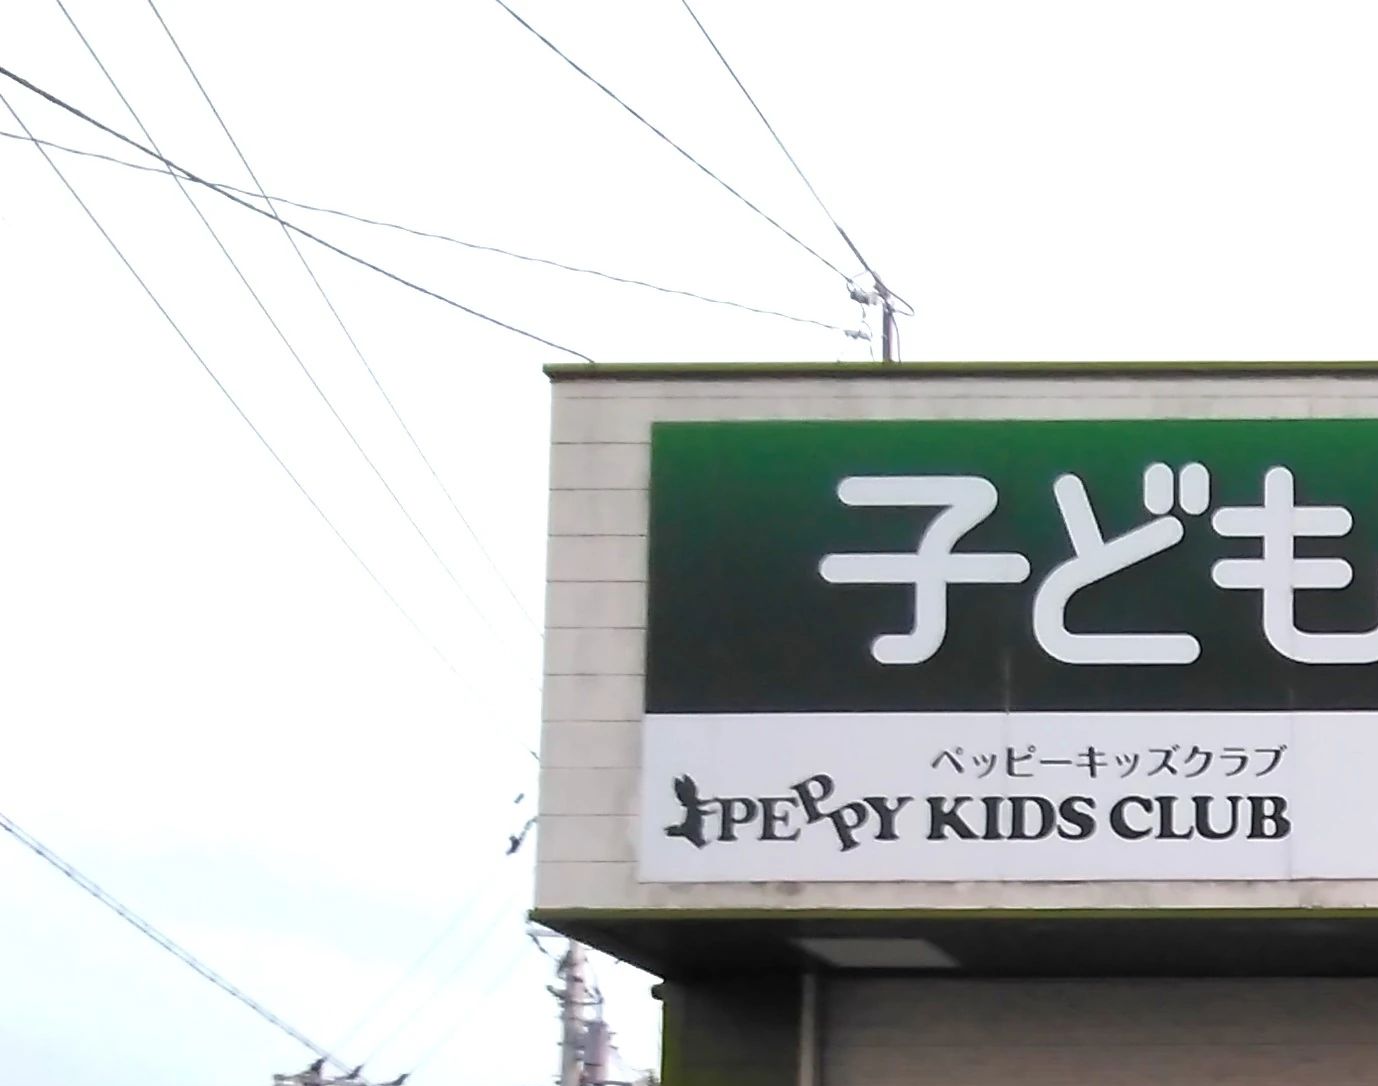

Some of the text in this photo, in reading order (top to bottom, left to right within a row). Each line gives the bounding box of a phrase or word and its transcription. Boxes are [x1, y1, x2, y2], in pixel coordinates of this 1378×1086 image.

[930, 743, 1289, 779] ペッピーキッズクラブ
[716, 772, 1292, 852] PEPPY KIDS CLUB
